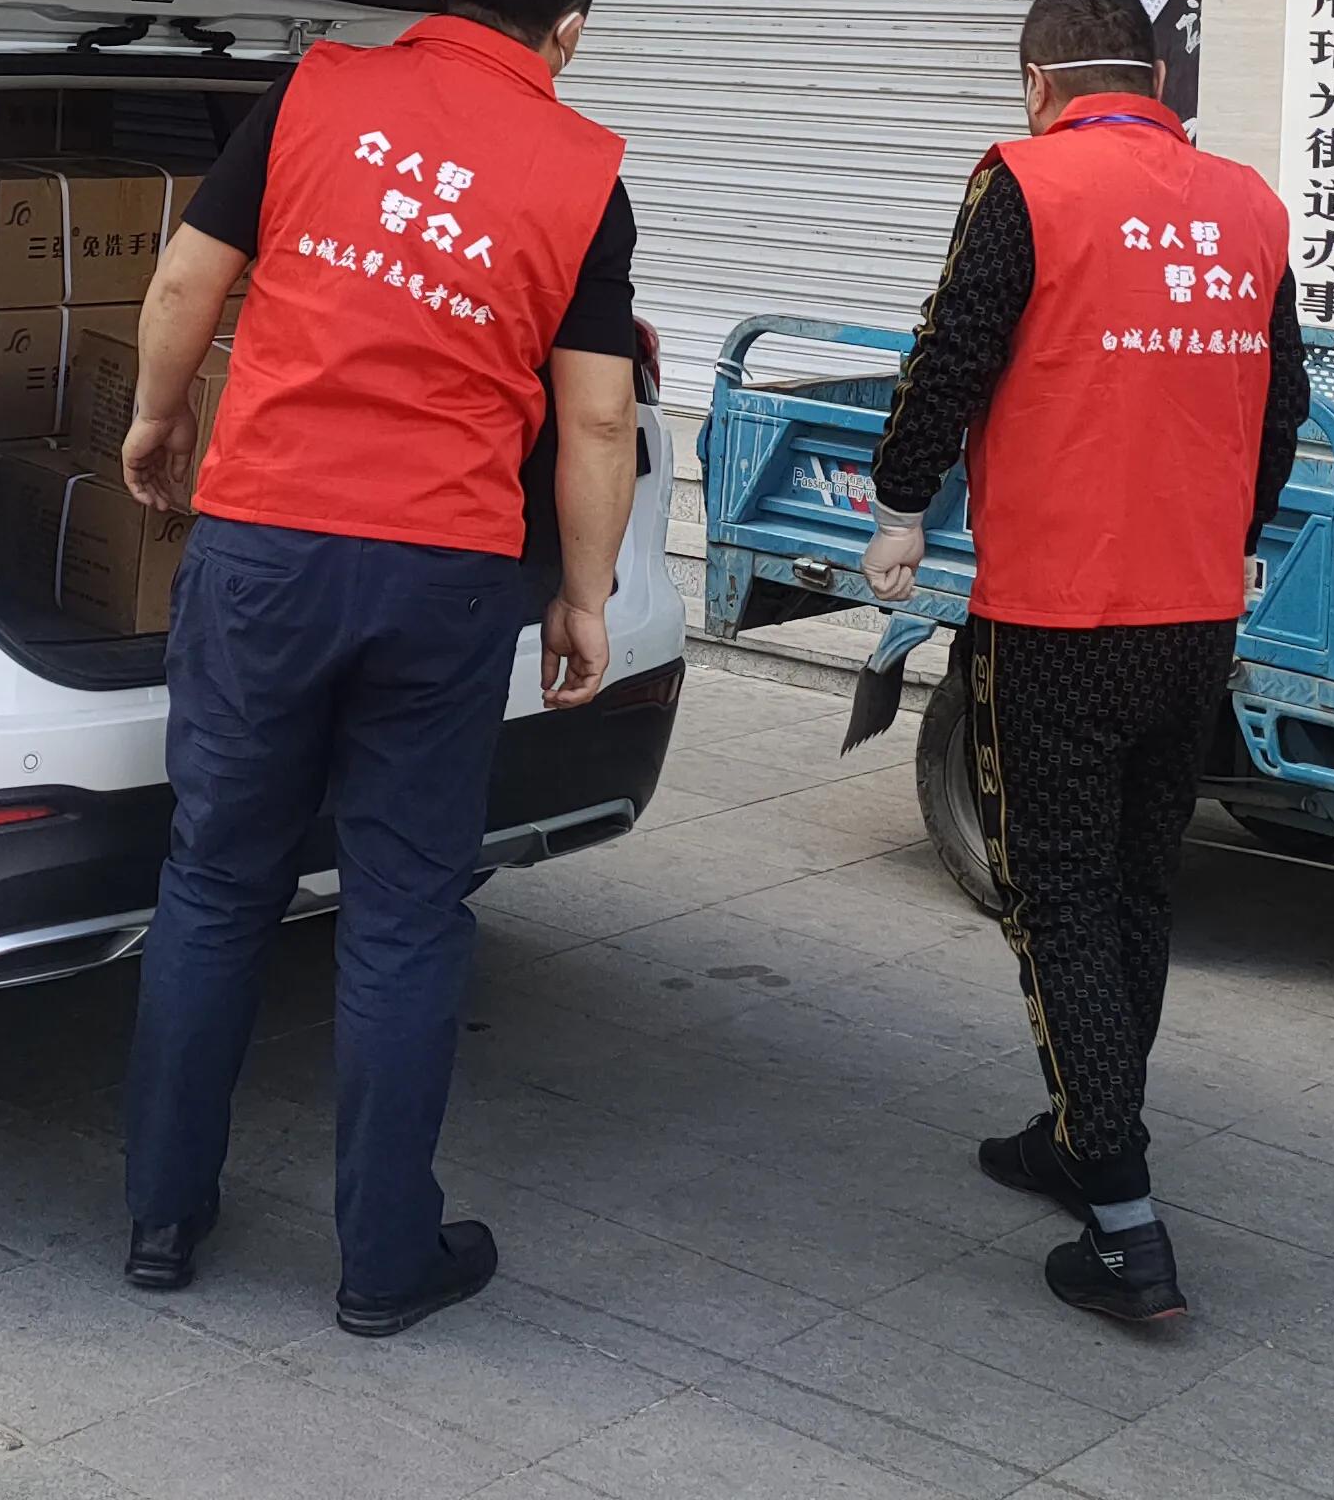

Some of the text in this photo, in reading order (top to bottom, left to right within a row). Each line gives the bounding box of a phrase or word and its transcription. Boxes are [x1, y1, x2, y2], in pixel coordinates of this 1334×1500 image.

[793, 466, 833, 494] Passion
[834, 483, 848, 497] on
[848, 486, 865, 503] my
